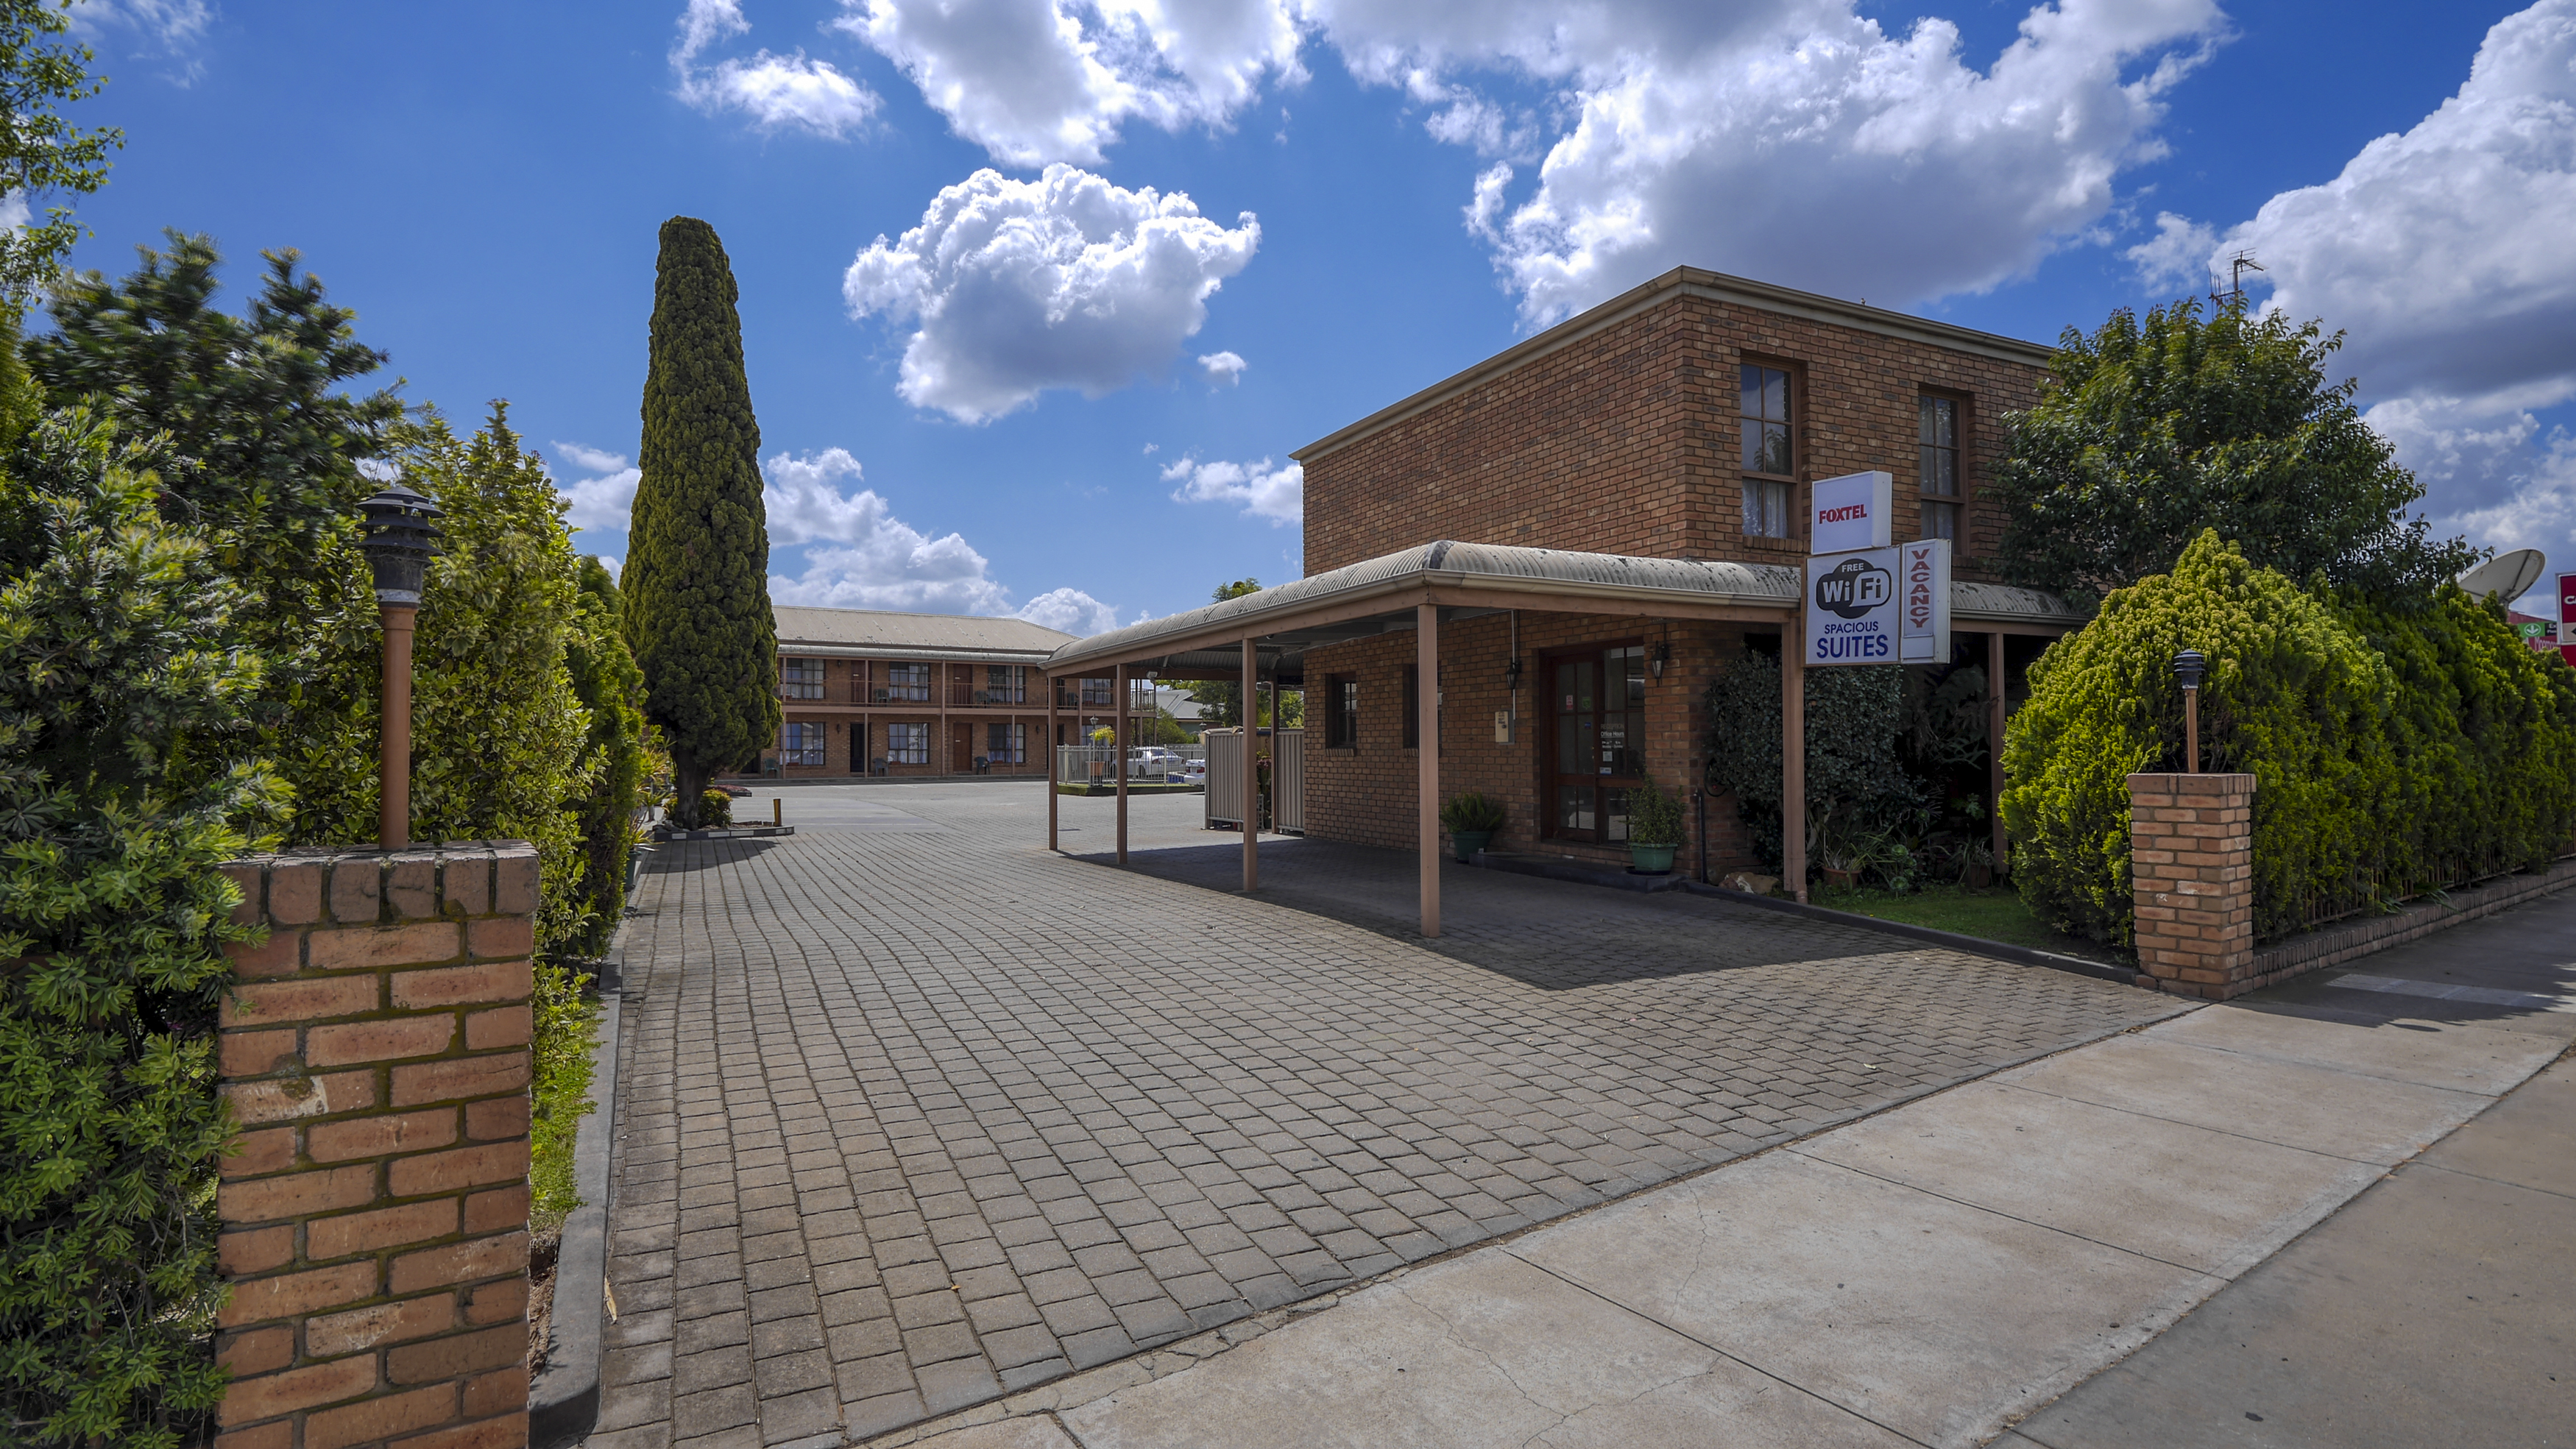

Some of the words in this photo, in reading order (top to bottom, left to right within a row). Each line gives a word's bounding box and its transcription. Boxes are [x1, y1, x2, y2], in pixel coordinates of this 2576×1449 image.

[1819, 503, 1867, 525] FOXTEL
[1841, 562, 1864, 573] FREE
[1910, 548, 1931, 628] VACANCY
[1824, 621, 1879, 634] SPACIOUS
[1816, 634, 1889, 659] SUITES
